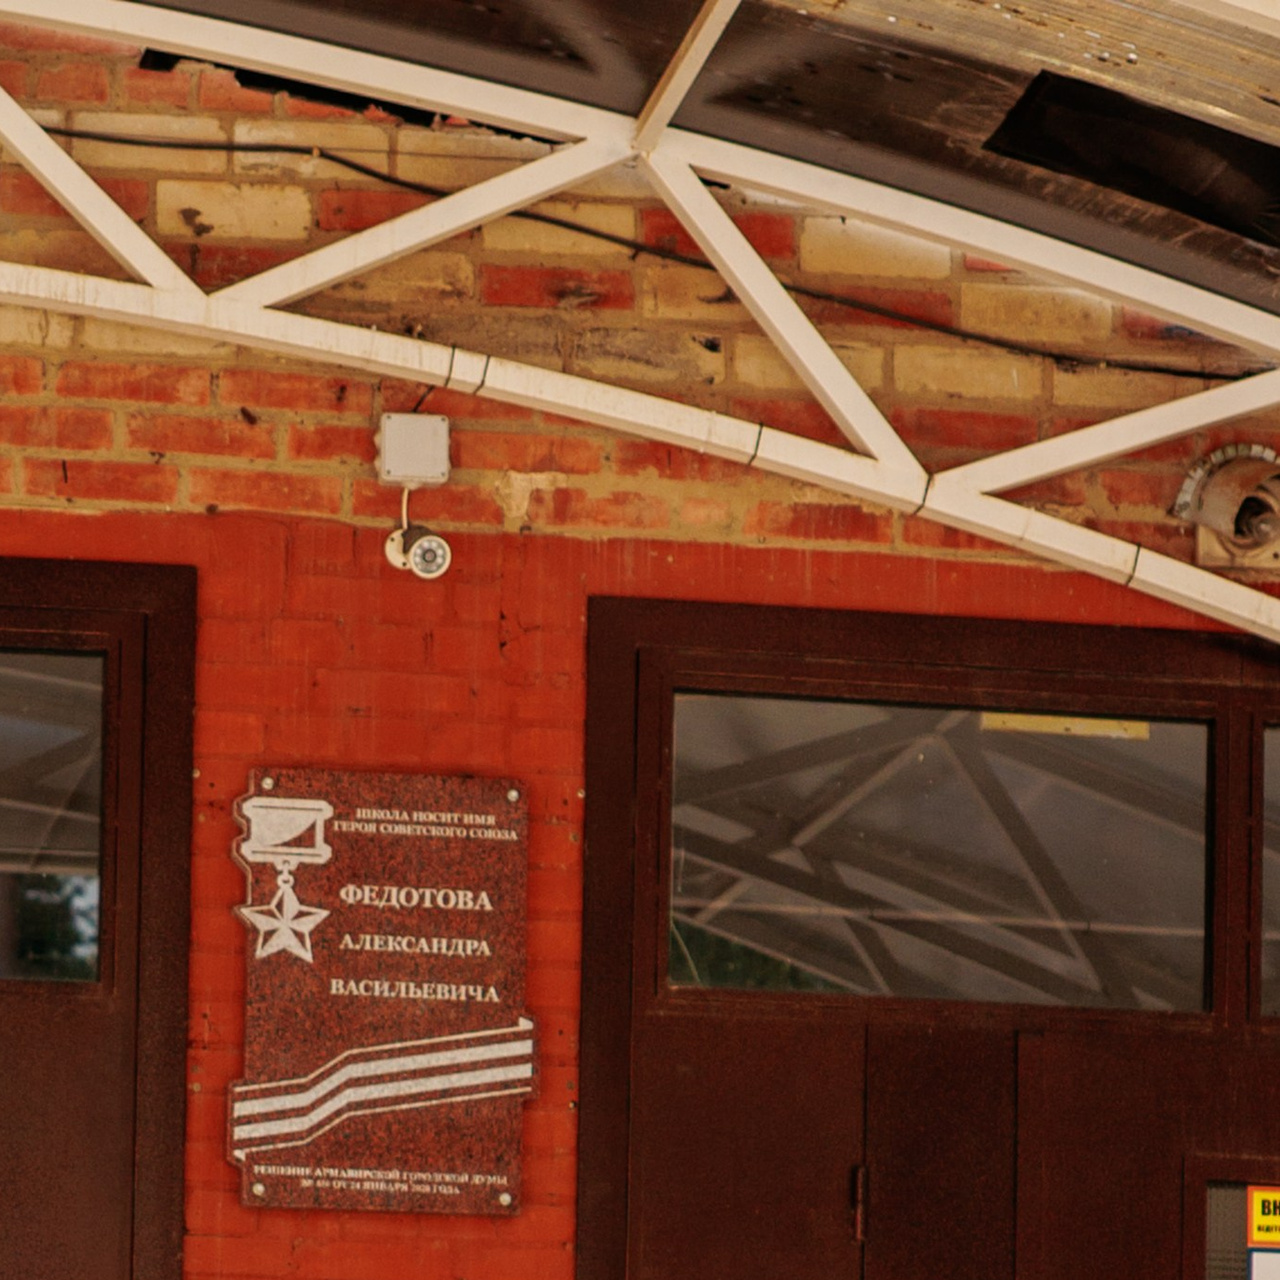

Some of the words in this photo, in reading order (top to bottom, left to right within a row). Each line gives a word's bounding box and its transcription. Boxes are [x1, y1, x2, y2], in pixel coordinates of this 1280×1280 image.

[356, 808, 410, 821] ШКОЛА
[412, 810, 461, 823] НОСИТ
[463, 814, 496, 825] ИМЯ
[333, 820, 377, 832] ГЕРОЯ
[380, 823, 466, 837] СОВЕТСКОГО
[469, 828, 518, 841] СОЮЗА
[338, 883, 493, 912] ФЕДОТОВА
[339, 933, 492, 957] АЛЕКСАНДРА
[330, 978, 500, 1003] ВАСИЛЬЕВИЧА
[254, 1164, 312, 1177] РЕШЕНИЕ
[314, 1167, 399, 1181] АРМАВИРСКОЙ
[402, 1170, 469, 1185] ГОРОДСКОЙ
[471, 1174, 508, 1186] ДУМЫ
